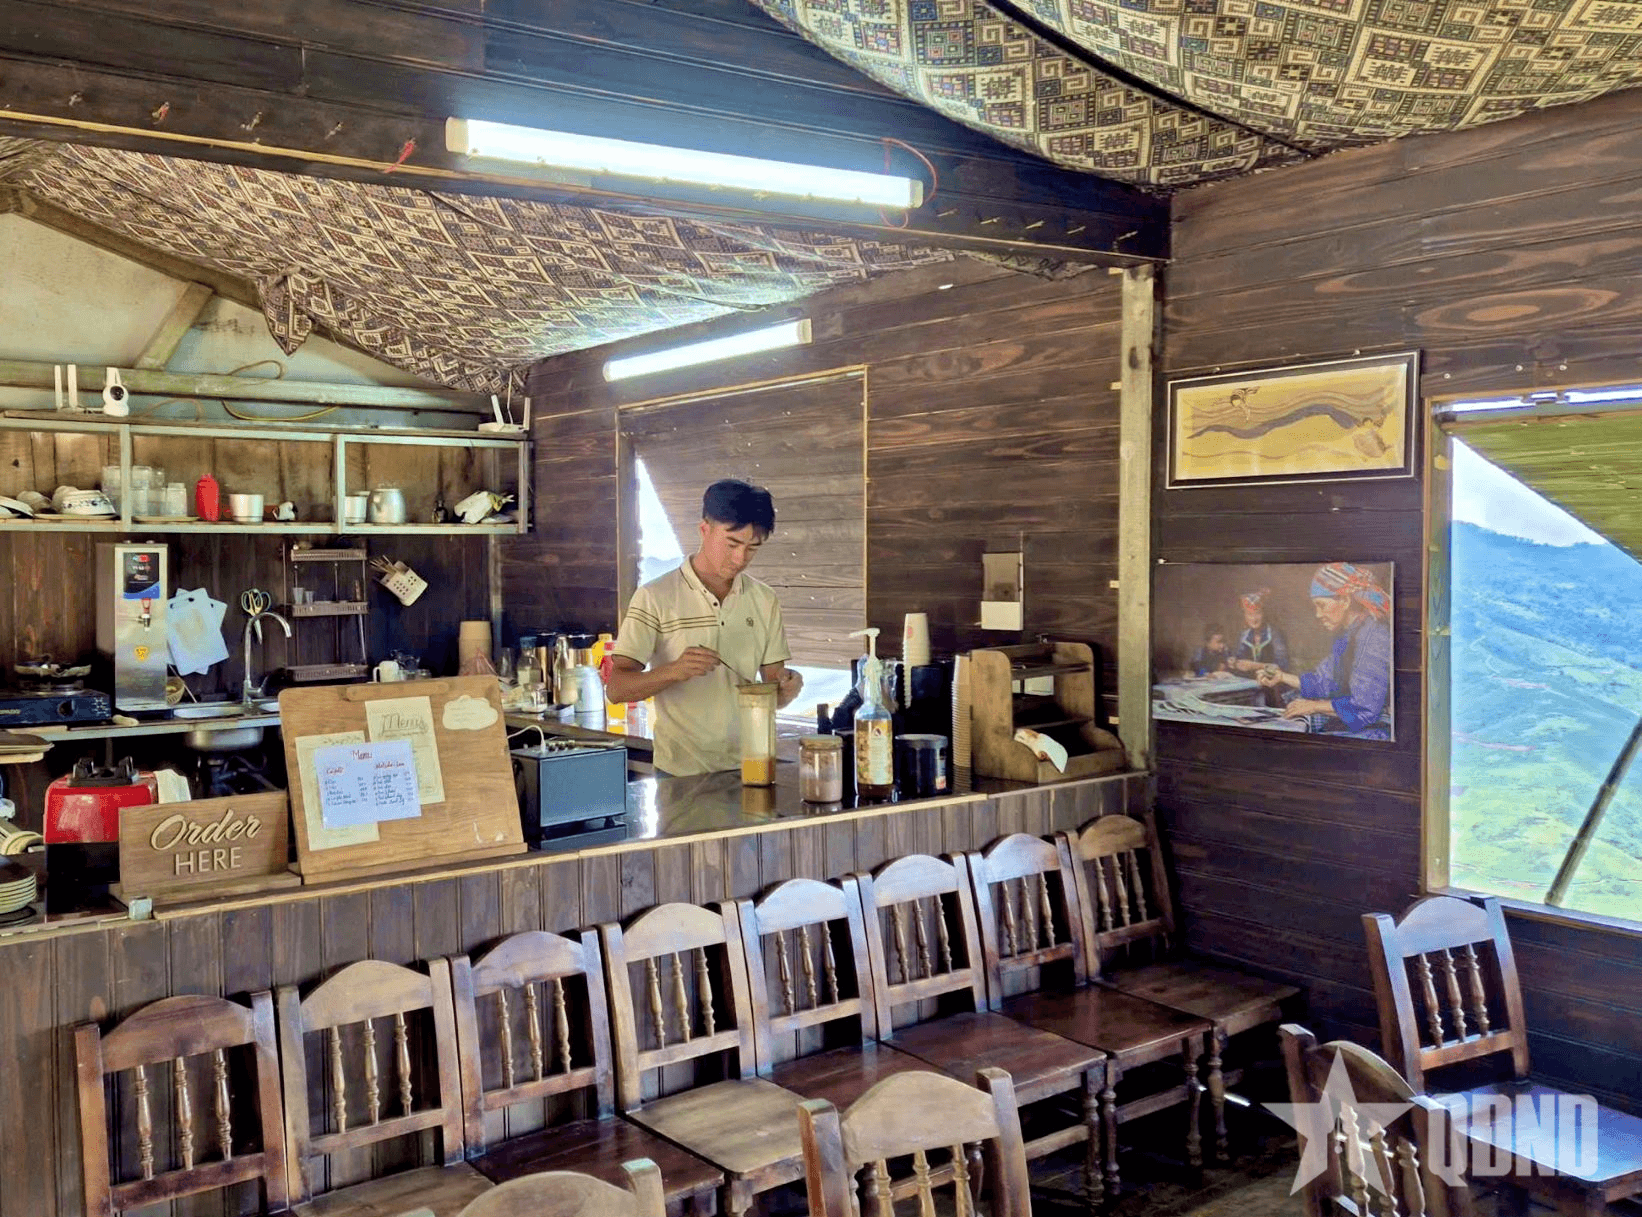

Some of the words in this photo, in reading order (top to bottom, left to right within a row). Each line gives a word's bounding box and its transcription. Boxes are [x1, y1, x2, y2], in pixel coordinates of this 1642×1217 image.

[351, 749, 373, 760] Menu
[150, 808, 262, 850] Order
[174, 847, 242, 876] HERE
